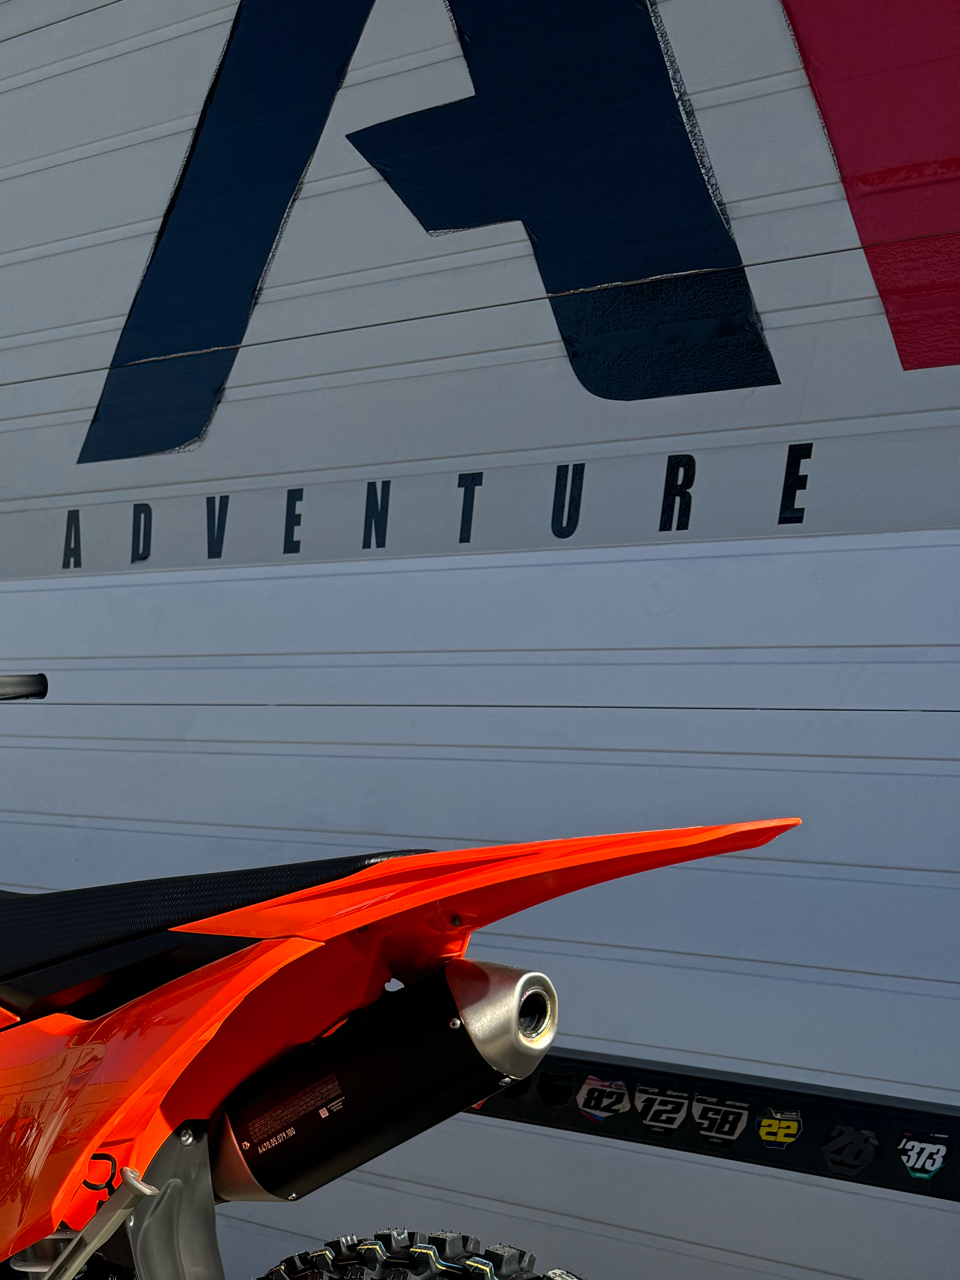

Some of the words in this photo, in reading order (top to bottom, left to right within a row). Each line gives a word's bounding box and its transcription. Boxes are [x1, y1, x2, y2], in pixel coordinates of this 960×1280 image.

[61, 442, 814, 570] ADVENTURE
[581, 1087, 627, 1114] 82
[640, 1096, 685, 1126] 12
[696, 1106, 744, 1137] 58
[759, 1118, 799, 1143] 22
[901, 1141, 947, 1171] 373
